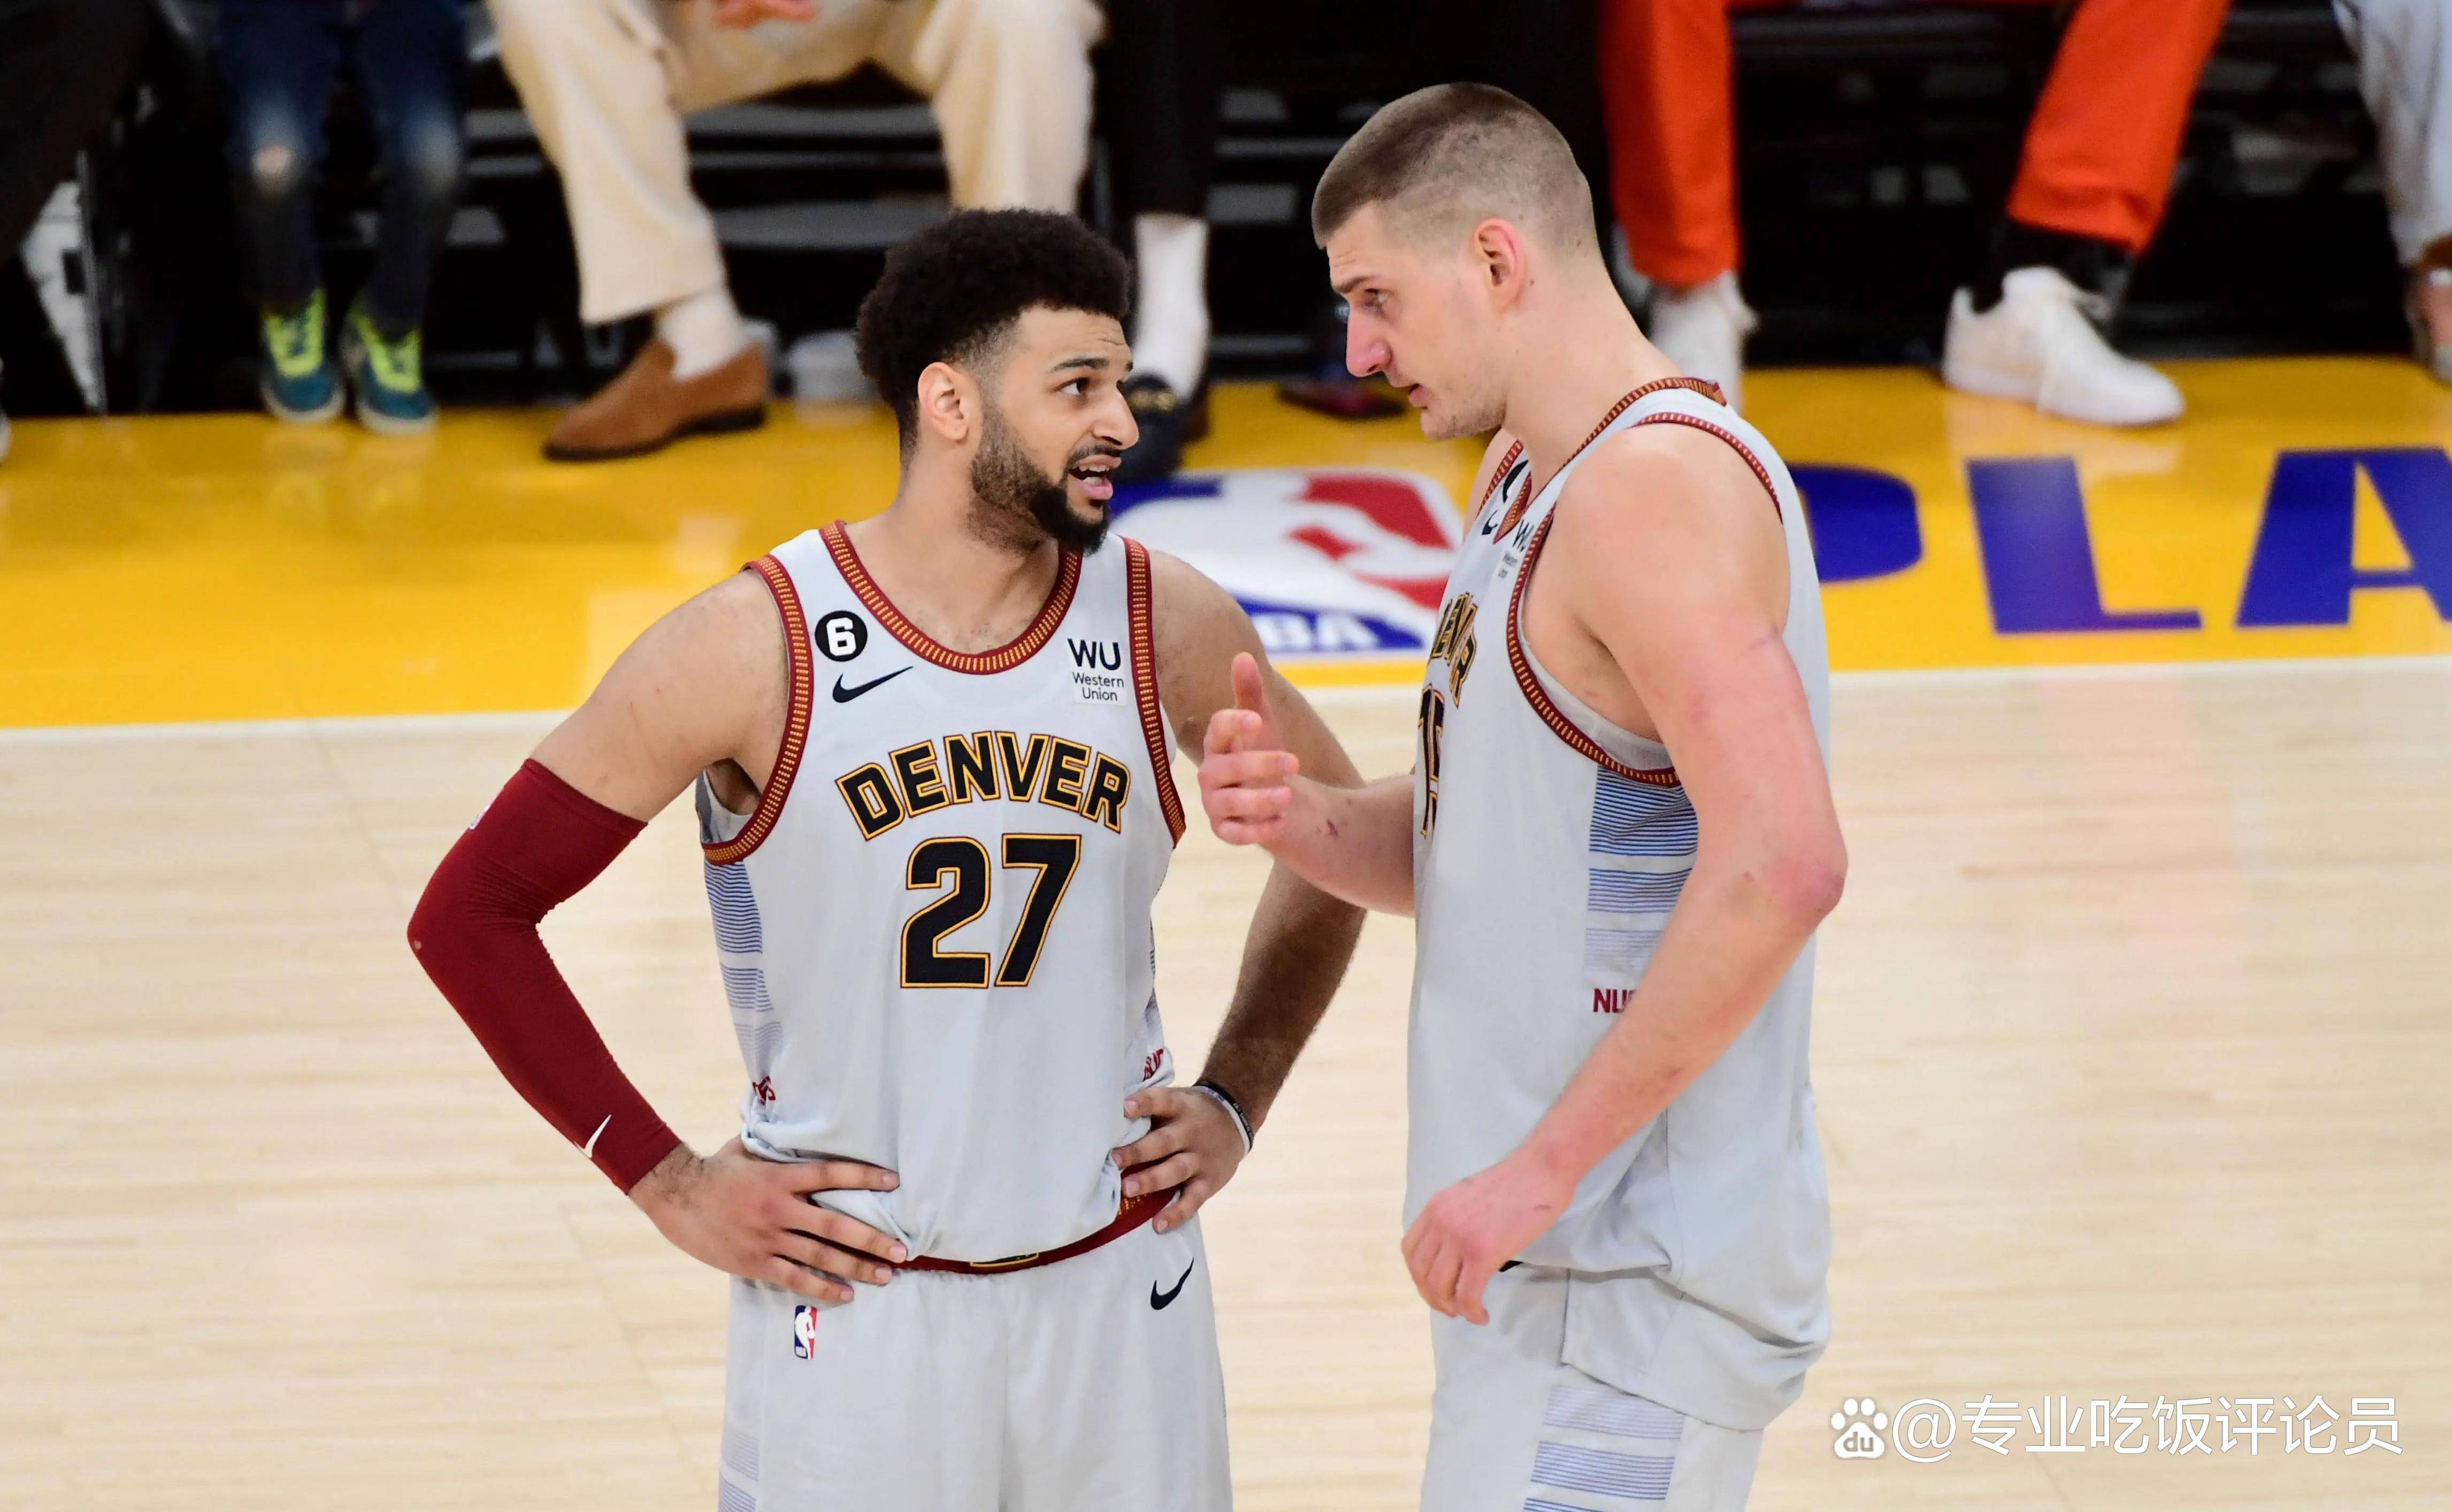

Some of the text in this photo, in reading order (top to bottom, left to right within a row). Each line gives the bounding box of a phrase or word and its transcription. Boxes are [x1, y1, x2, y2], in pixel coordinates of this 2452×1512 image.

[826, 617, 856, 657] 6
[1067, 638, 1121, 671] WU
[1071, 671, 1124, 688] Western
[1082, 687, 1118, 702] Union
[834, 731, 1130, 841] DENVER
[900, 833, 1082, 989] 27
[1593, 988, 1636, 1014] NU
